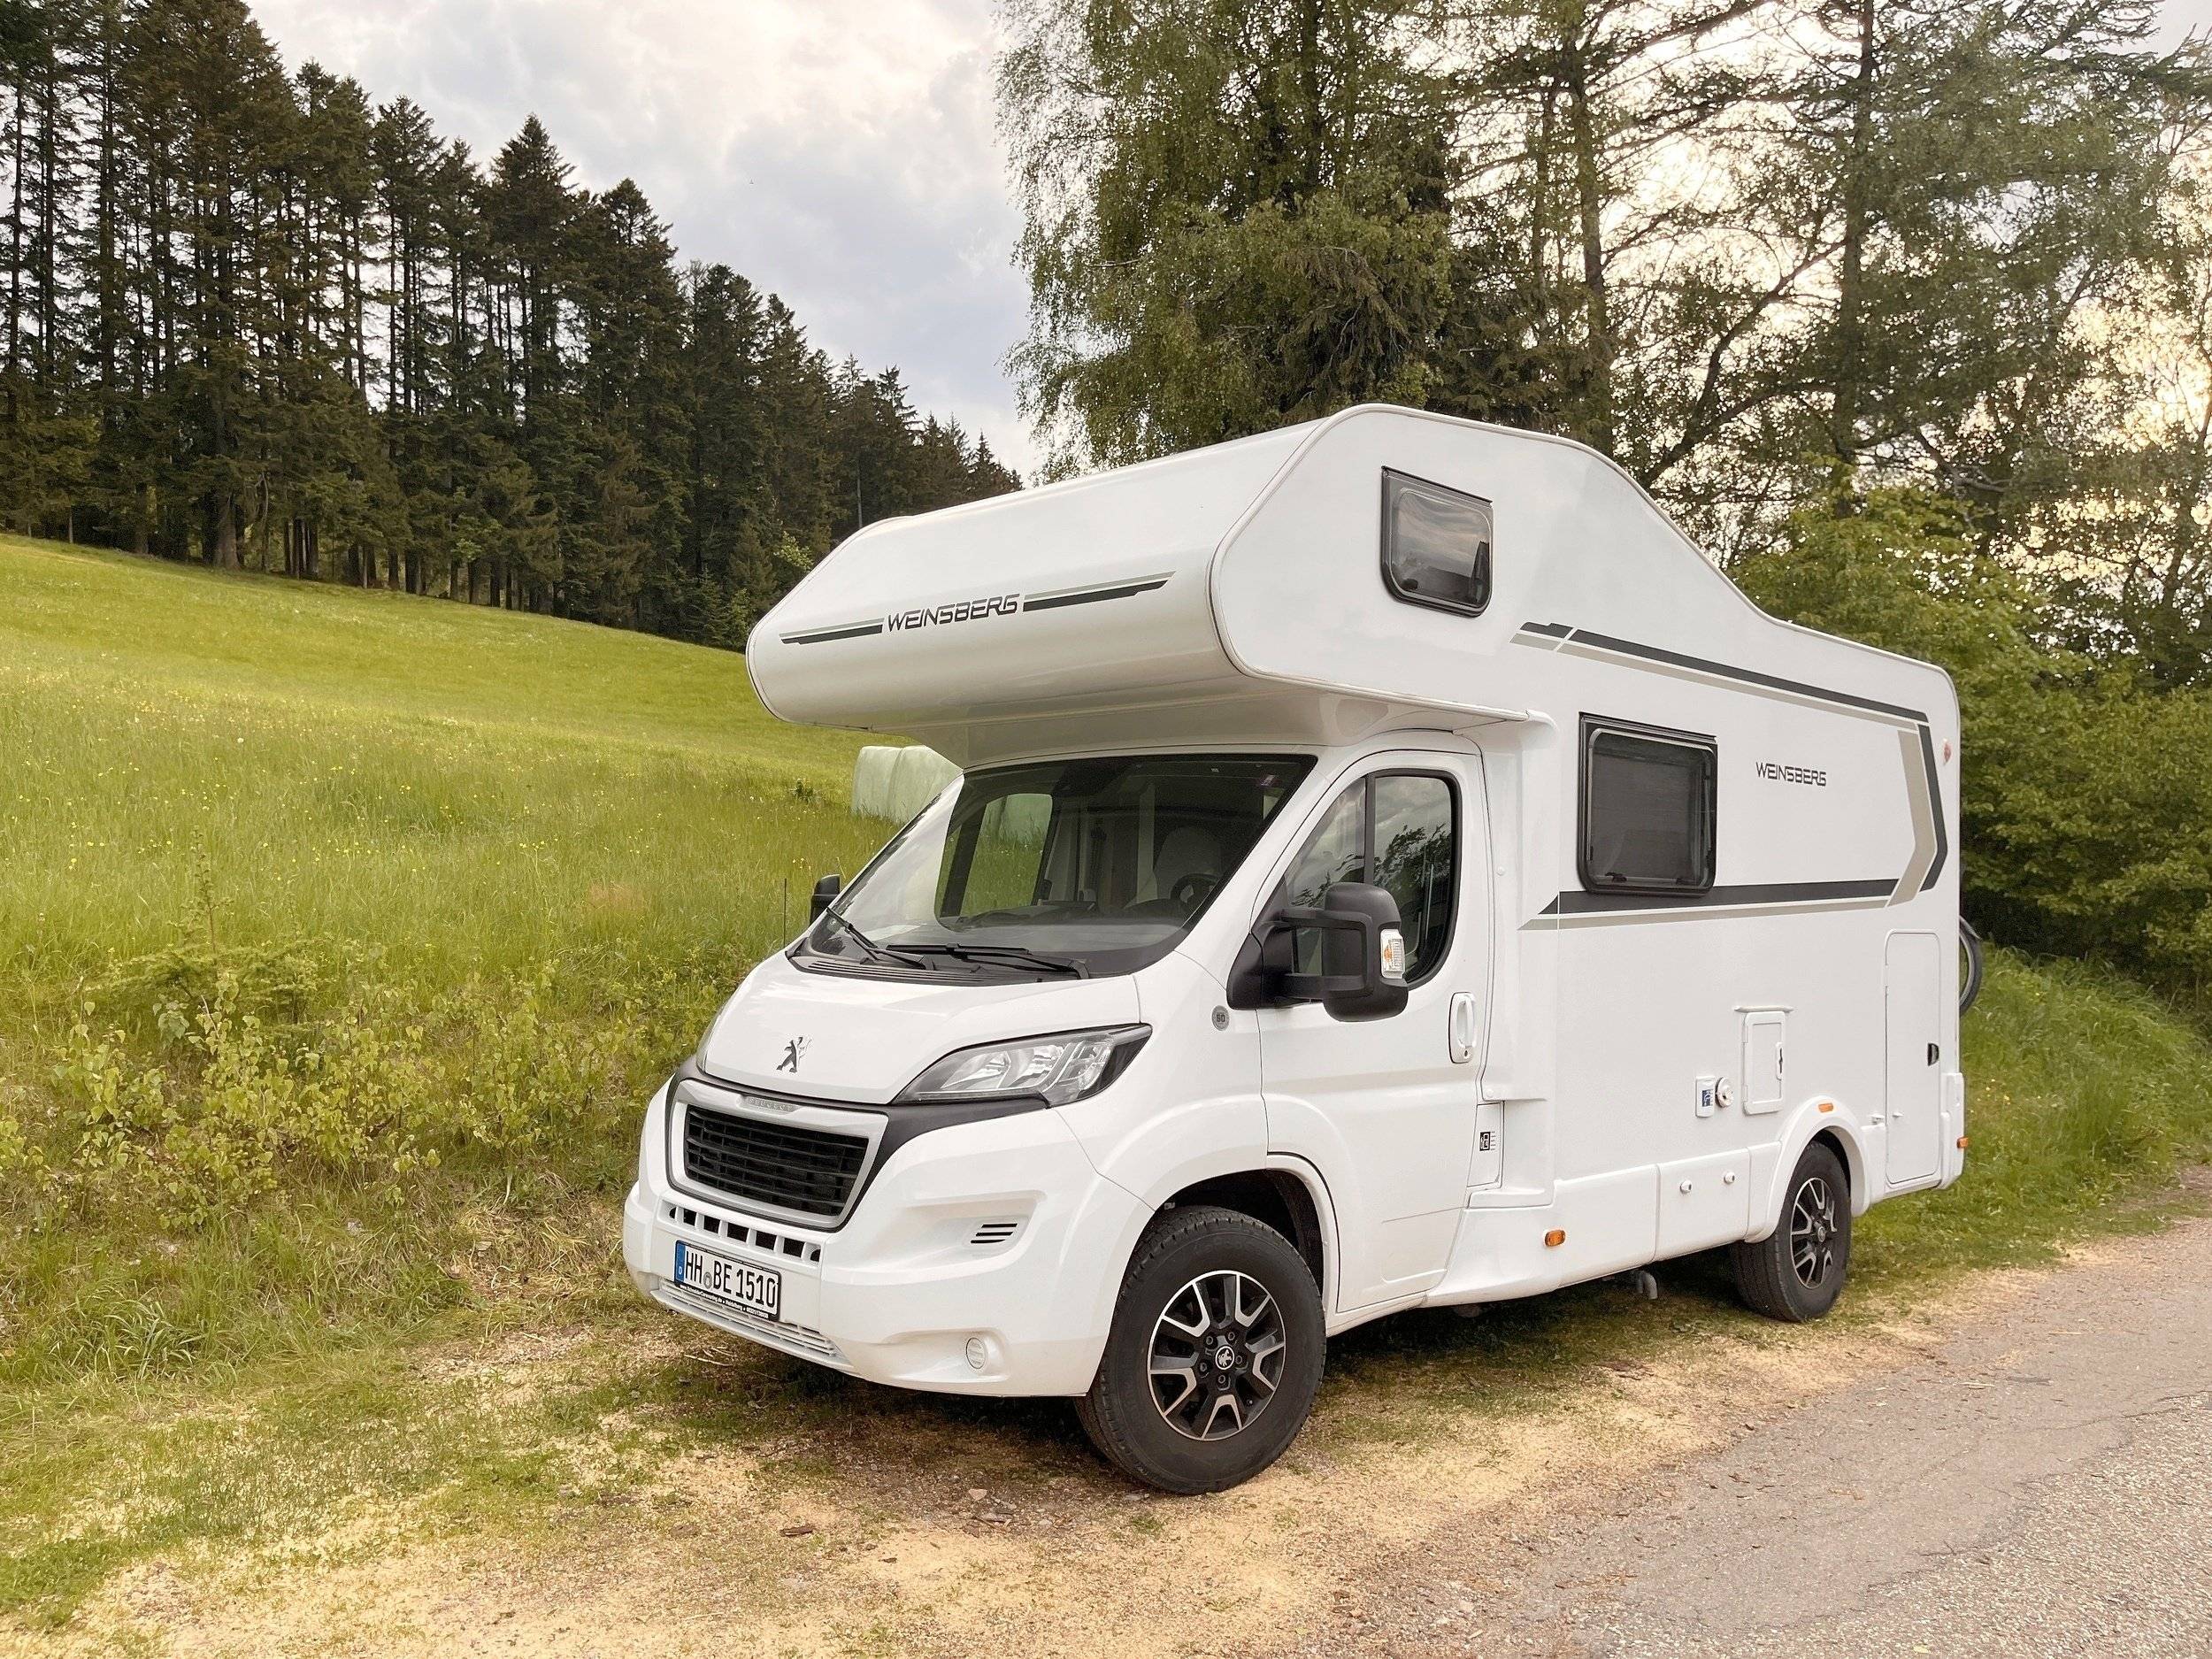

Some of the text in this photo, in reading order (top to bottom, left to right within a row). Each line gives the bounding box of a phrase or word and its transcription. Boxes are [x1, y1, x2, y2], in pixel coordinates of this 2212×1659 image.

[887, 594, 1019, 632] WEINSBERG
[1755, 762, 1826, 787] WEINSBERG
[685, 1250, 703, 1284] HH
[713, 1260, 733, 1294] BE
[735, 1269, 776, 1308] 1510
